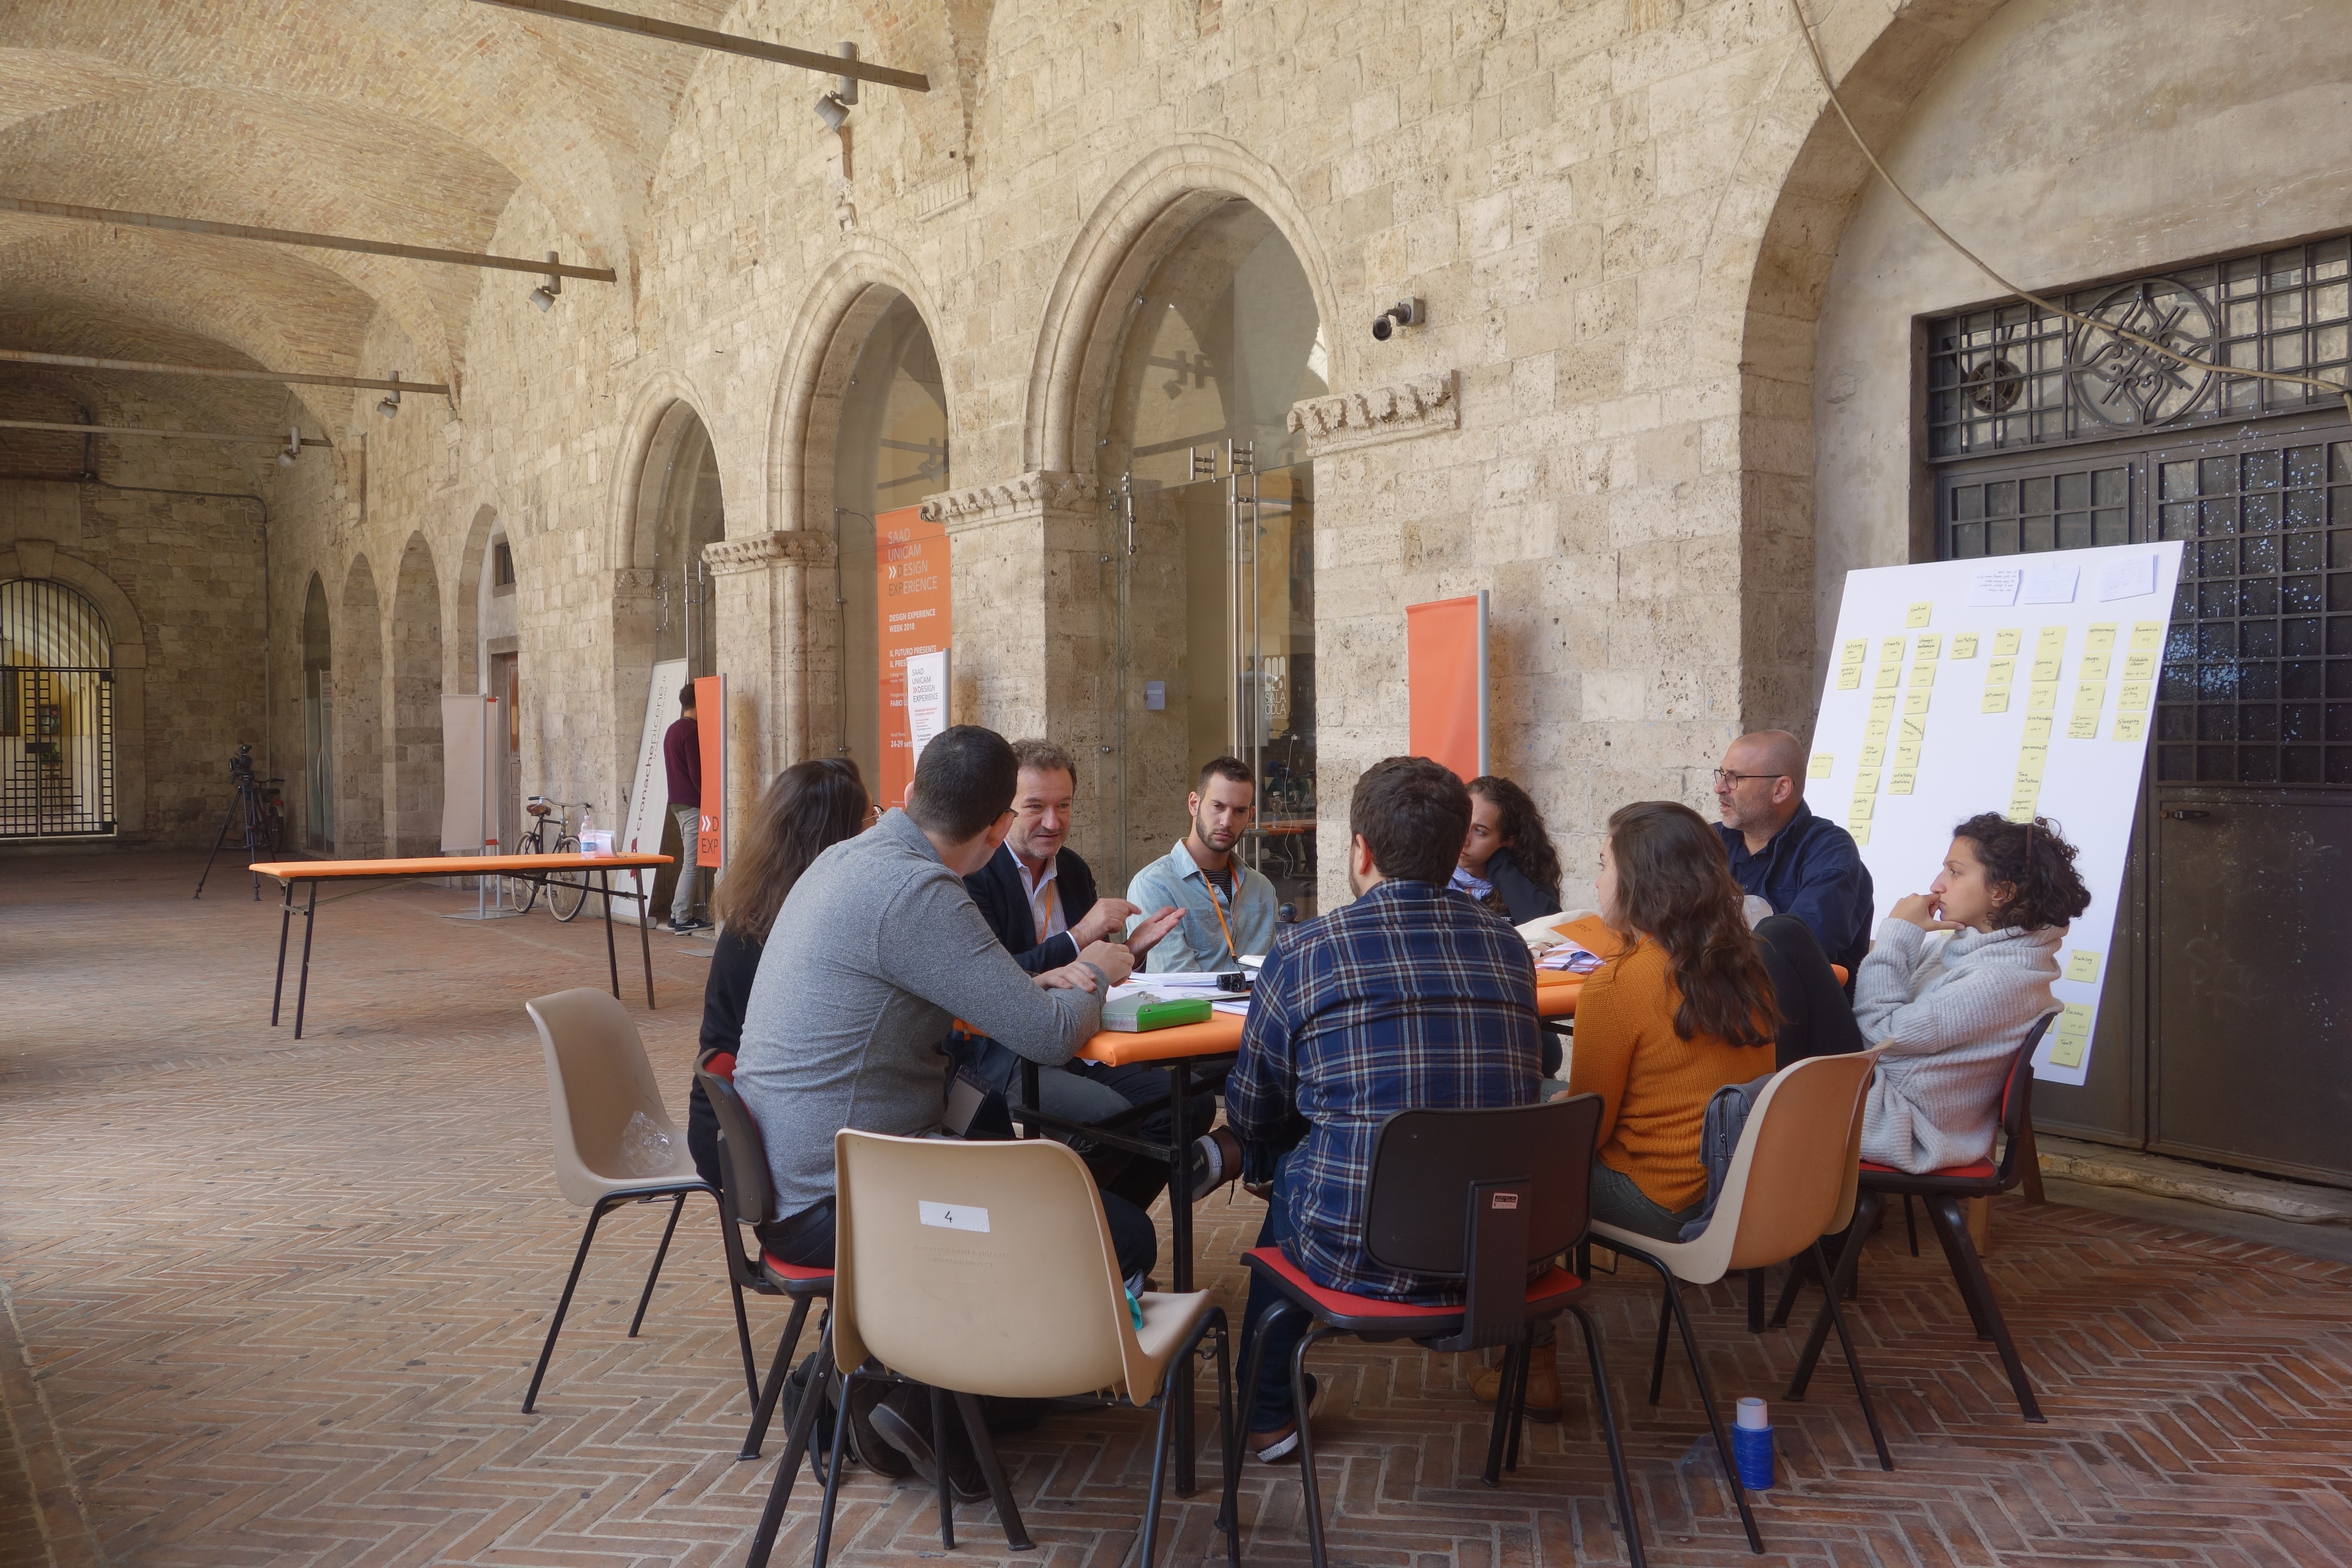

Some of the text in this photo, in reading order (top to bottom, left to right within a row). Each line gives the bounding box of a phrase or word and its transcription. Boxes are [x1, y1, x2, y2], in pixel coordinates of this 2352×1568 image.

[888, 528, 910, 544] SAAD
[888, 543, 921, 562] UNICAM
[897, 559, 928, 577] DESIGN
[889, 576, 937, 596] EXPERIENCE
[889, 608, 936, 622] DESIGN EXPERIENCE
[889, 622, 915, 632] WEEK 2018
[895, 647, 913, 656] FUTURO
[914, 645, 937, 655] PRESENTE
[912, 676, 931, 685] UNICAM
[918, 684, 935, 693] DESIGN
[913, 693, 938, 702] EXPERIENCE
[1265, 691, 1286, 704] SALA
[1265, 703, 1286, 715] COLA
[712, 816, 719, 832] D
[702, 839, 718, 854] EXP
[944, 1211, 952, 1224] 4
[937, 1246, 970, 1255] ORLANDO
